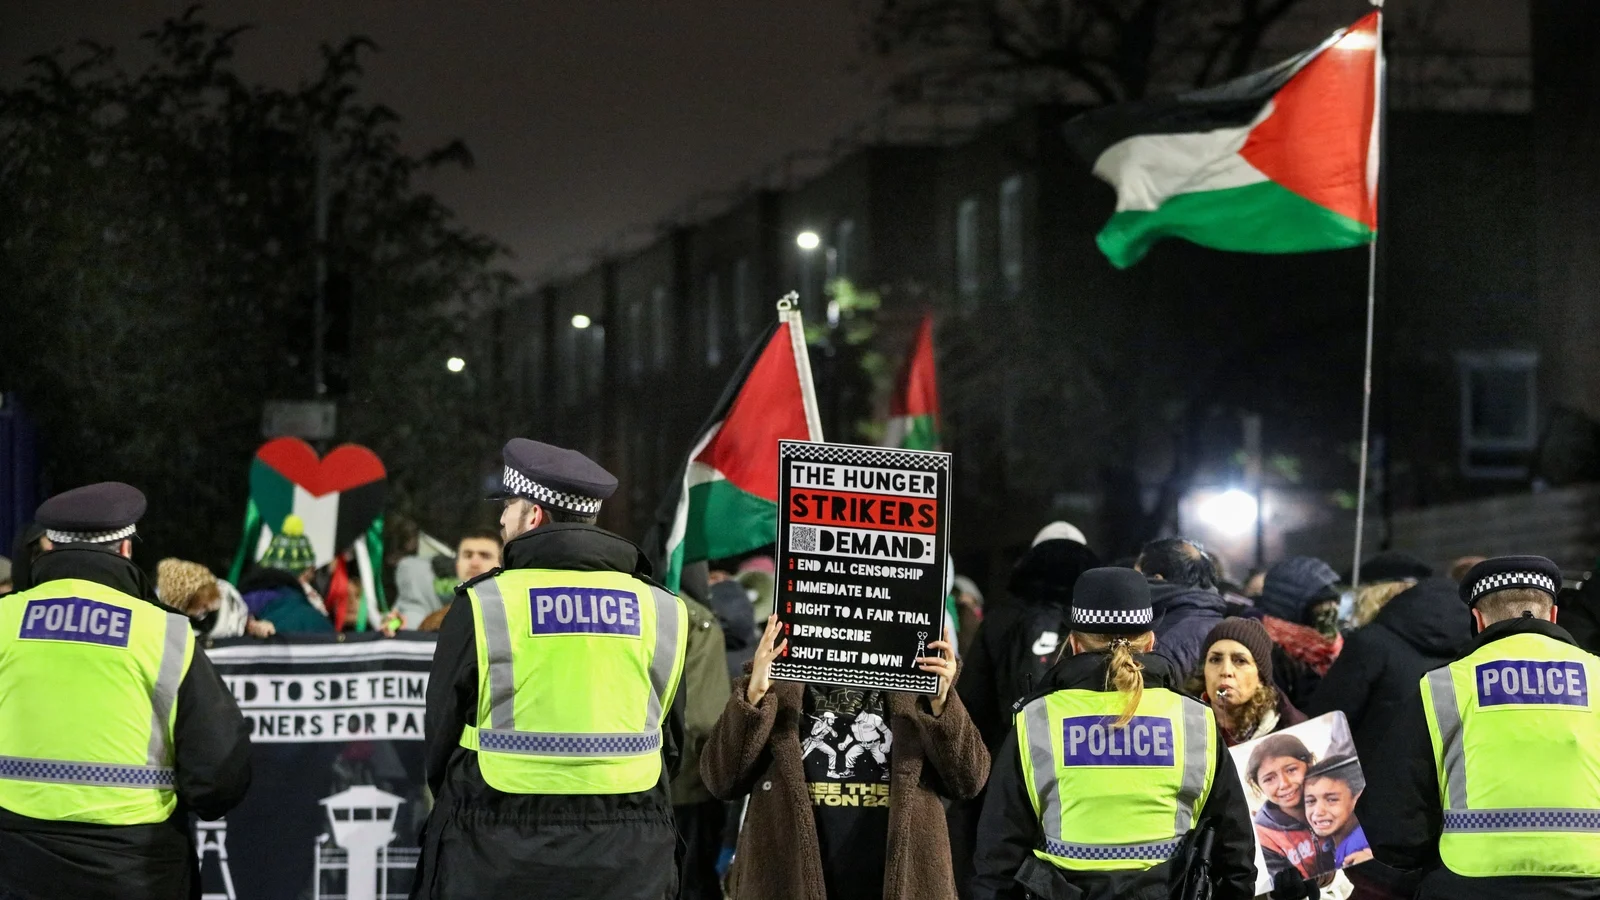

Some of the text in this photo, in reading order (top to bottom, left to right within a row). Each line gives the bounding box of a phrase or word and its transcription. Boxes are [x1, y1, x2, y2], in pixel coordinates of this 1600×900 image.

[792, 465, 935, 494] THE HUNGER
[792, 493, 934, 528] STRIKERS
[819, 530, 931, 559] DEMAND:
[797, 558, 923, 580] END ALL CENSORSHIP
[796, 580, 891, 600] IMMEDIATE BAIL
[26, 604, 127, 638] POLICE
[536, 594, 635, 625] POLICE
[794, 602, 931, 625] RIGHT TO A FAIR TRIAL
[793, 624, 872, 642] DEPROSCRIBE
[791, 646, 903, 667] SHUT ELBIT DOWN!
[270, 680, 302, 701] TO
[313, 680, 358, 701] SDE
[366, 677, 424, 699] TEIM
[1482, 667, 1582, 696] POLICE
[334, 713, 375, 735] FOR
[387, 712, 426, 734] PA
[1069, 724, 1168, 757] POLICE
[845, 783, 889, 795] THE
